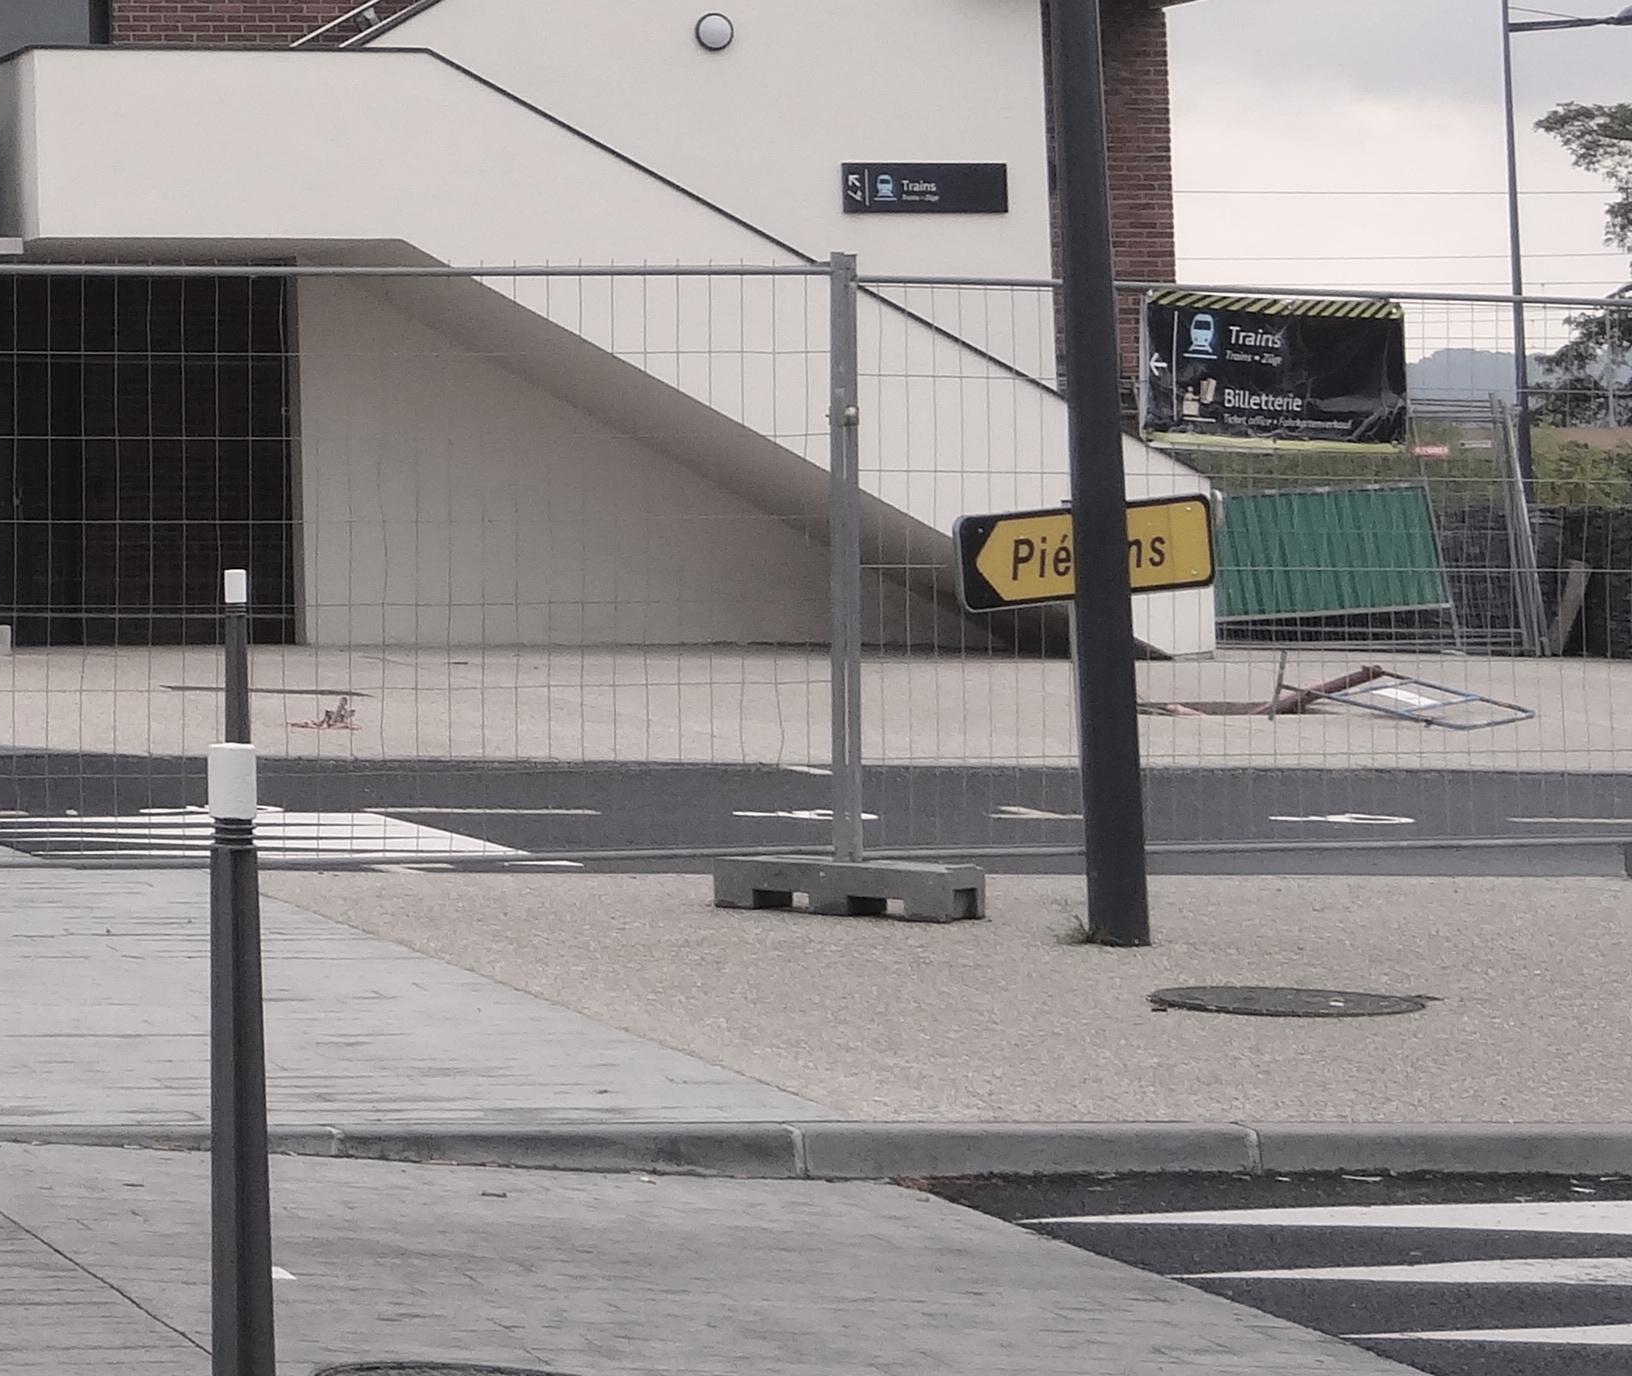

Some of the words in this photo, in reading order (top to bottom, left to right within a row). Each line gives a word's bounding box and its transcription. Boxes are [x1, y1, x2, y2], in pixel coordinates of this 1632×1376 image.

[901, 179, 937, 192] Trains
[1228, 325, 1283, 348] Trains
[1223, 388, 1303, 412] Billetterie
[1011, 534, 1166, 582] Piéns
